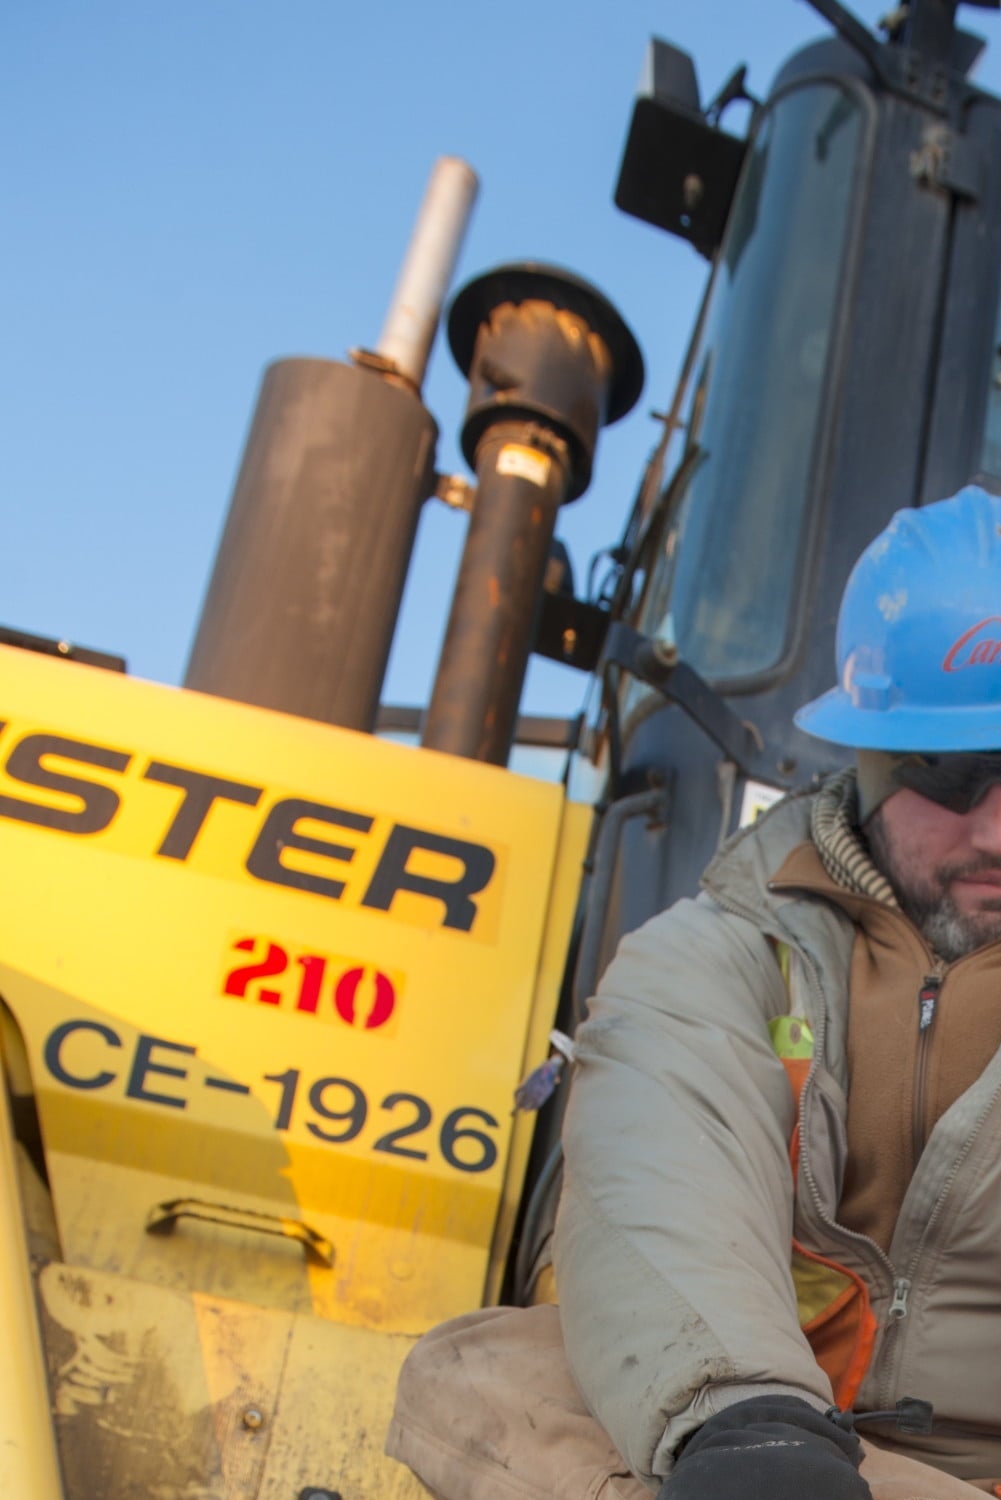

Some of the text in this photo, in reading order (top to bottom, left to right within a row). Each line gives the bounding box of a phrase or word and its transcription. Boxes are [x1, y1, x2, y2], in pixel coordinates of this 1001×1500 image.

[0, 720, 496, 933] STER
[223, 938, 396, 1030] 210
[43, 1019, 501, 1174] CE-1926
